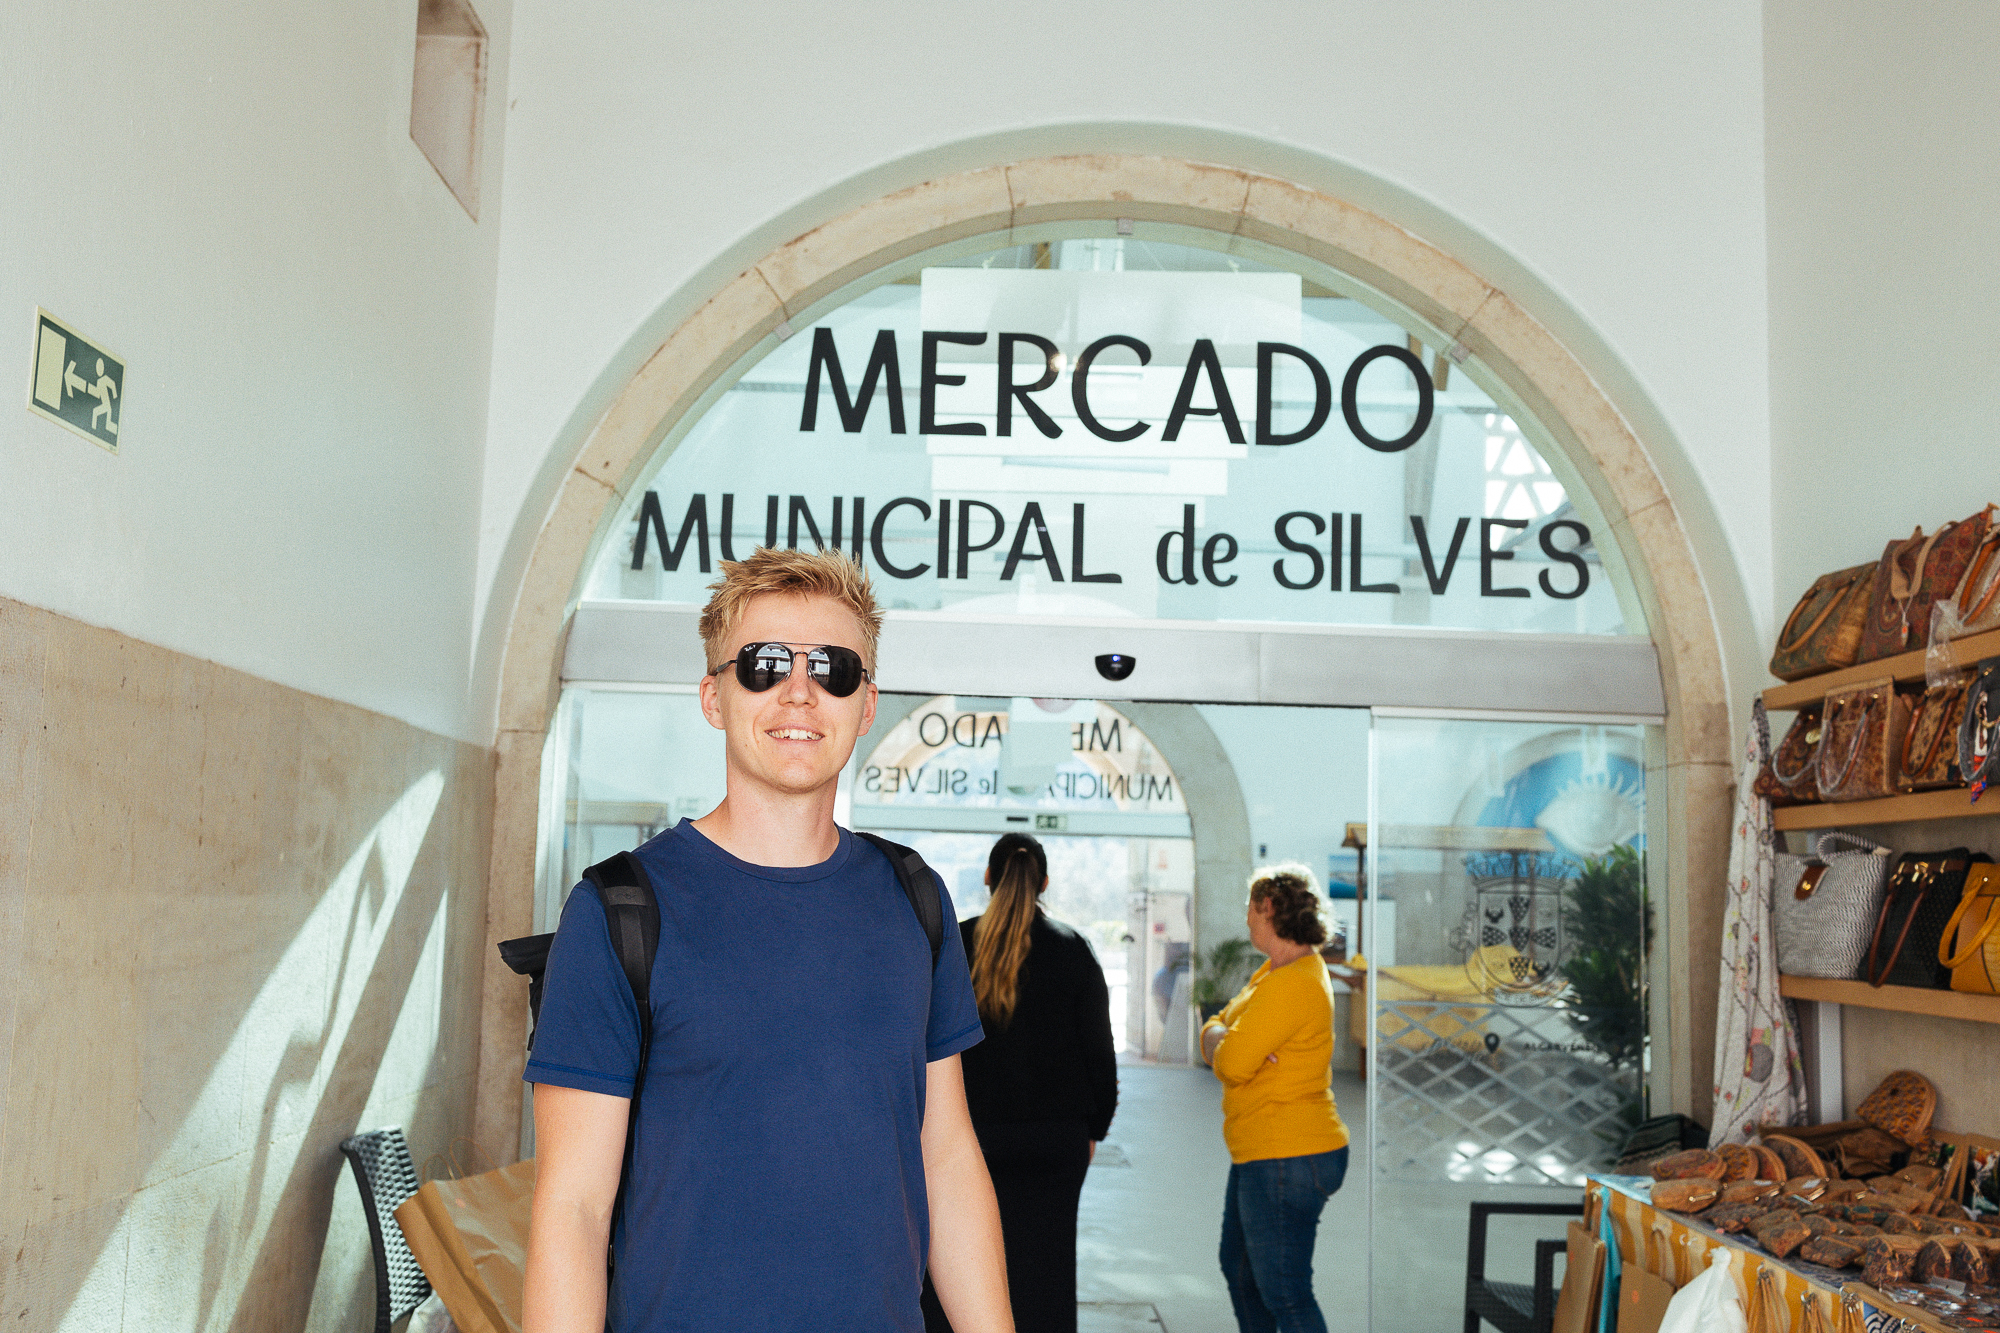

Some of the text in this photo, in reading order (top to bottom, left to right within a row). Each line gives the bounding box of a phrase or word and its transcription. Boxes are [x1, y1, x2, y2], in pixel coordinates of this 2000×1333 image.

[799, 326, 1434, 453] MERCADO
[630, 490, 1592, 600] MUNICIPAL de SILVES
